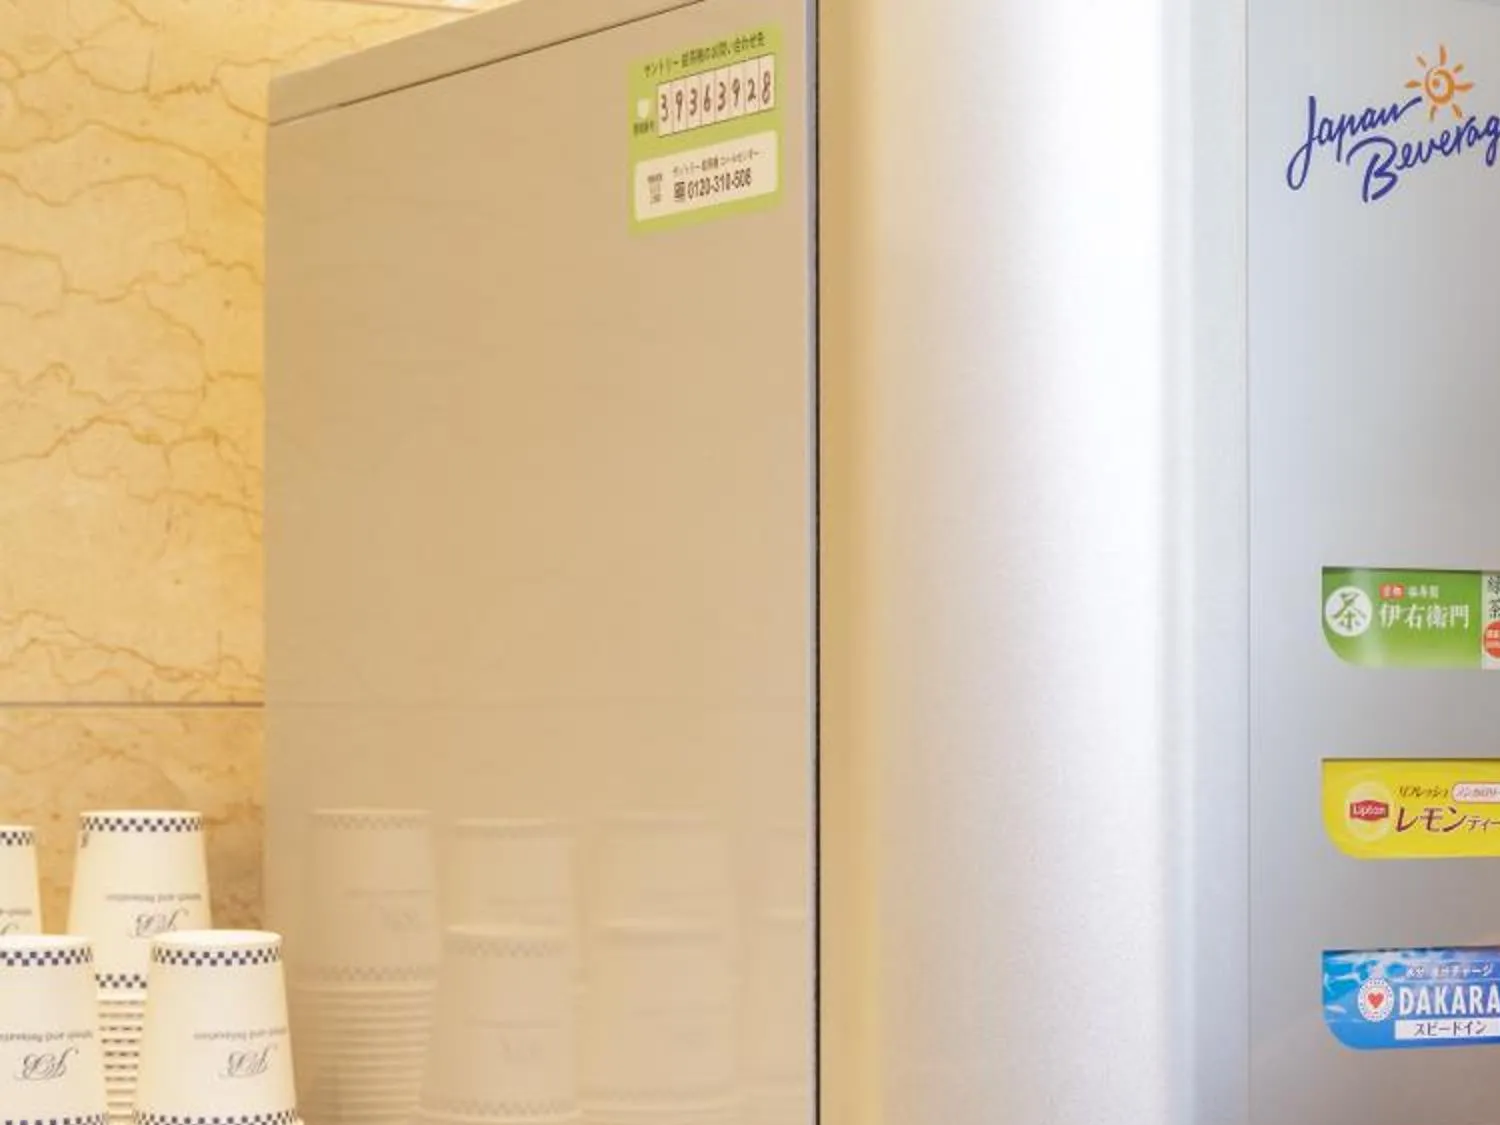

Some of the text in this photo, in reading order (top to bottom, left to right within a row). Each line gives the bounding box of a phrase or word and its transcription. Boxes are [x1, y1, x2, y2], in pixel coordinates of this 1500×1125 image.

[660, 71, 771, 121] 39363928
[1287, 96, 1423, 190] Japan
[1331, 591, 1368, 632] 茶
[1379, 603, 1470, 629] 伊右衛門
[1413, 1022, 1488, 1037] スピードイン
